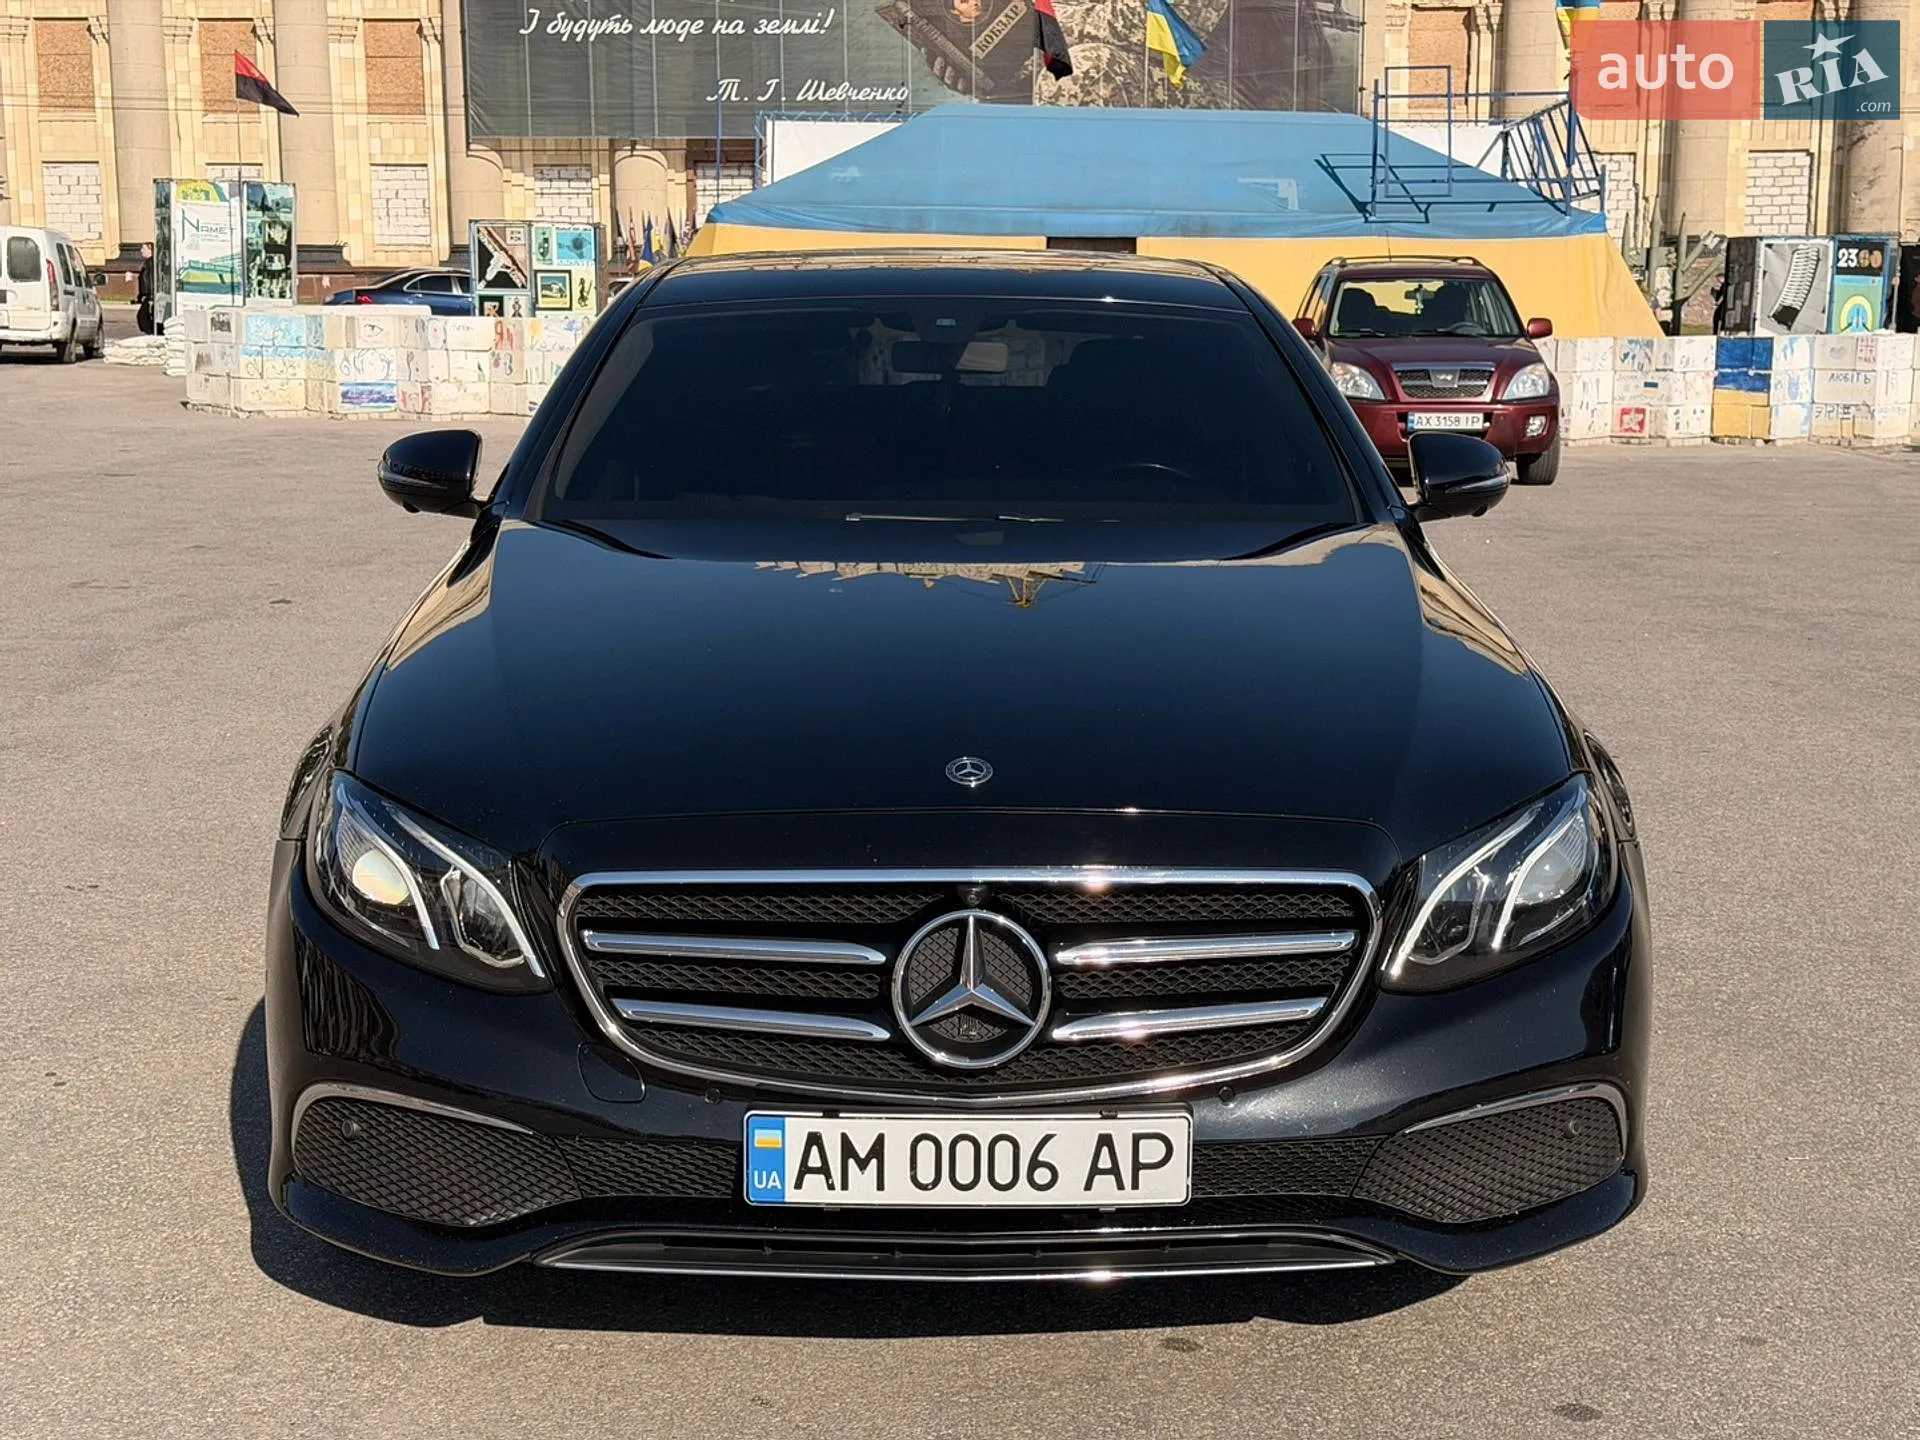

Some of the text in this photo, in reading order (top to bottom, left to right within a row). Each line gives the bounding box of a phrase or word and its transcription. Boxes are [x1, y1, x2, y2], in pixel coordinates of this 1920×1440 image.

[518, 7, 836, 42] І будуть люде на землі!
[975, 3, 1022, 55] КОБЗАР
[795, 78, 909, 101] Шевченко
[1435, 416, 1460, 427] 3158
[793, 1131, 1175, 1192] AM 0006 AP
[754, 1171, 782, 1190] UA
